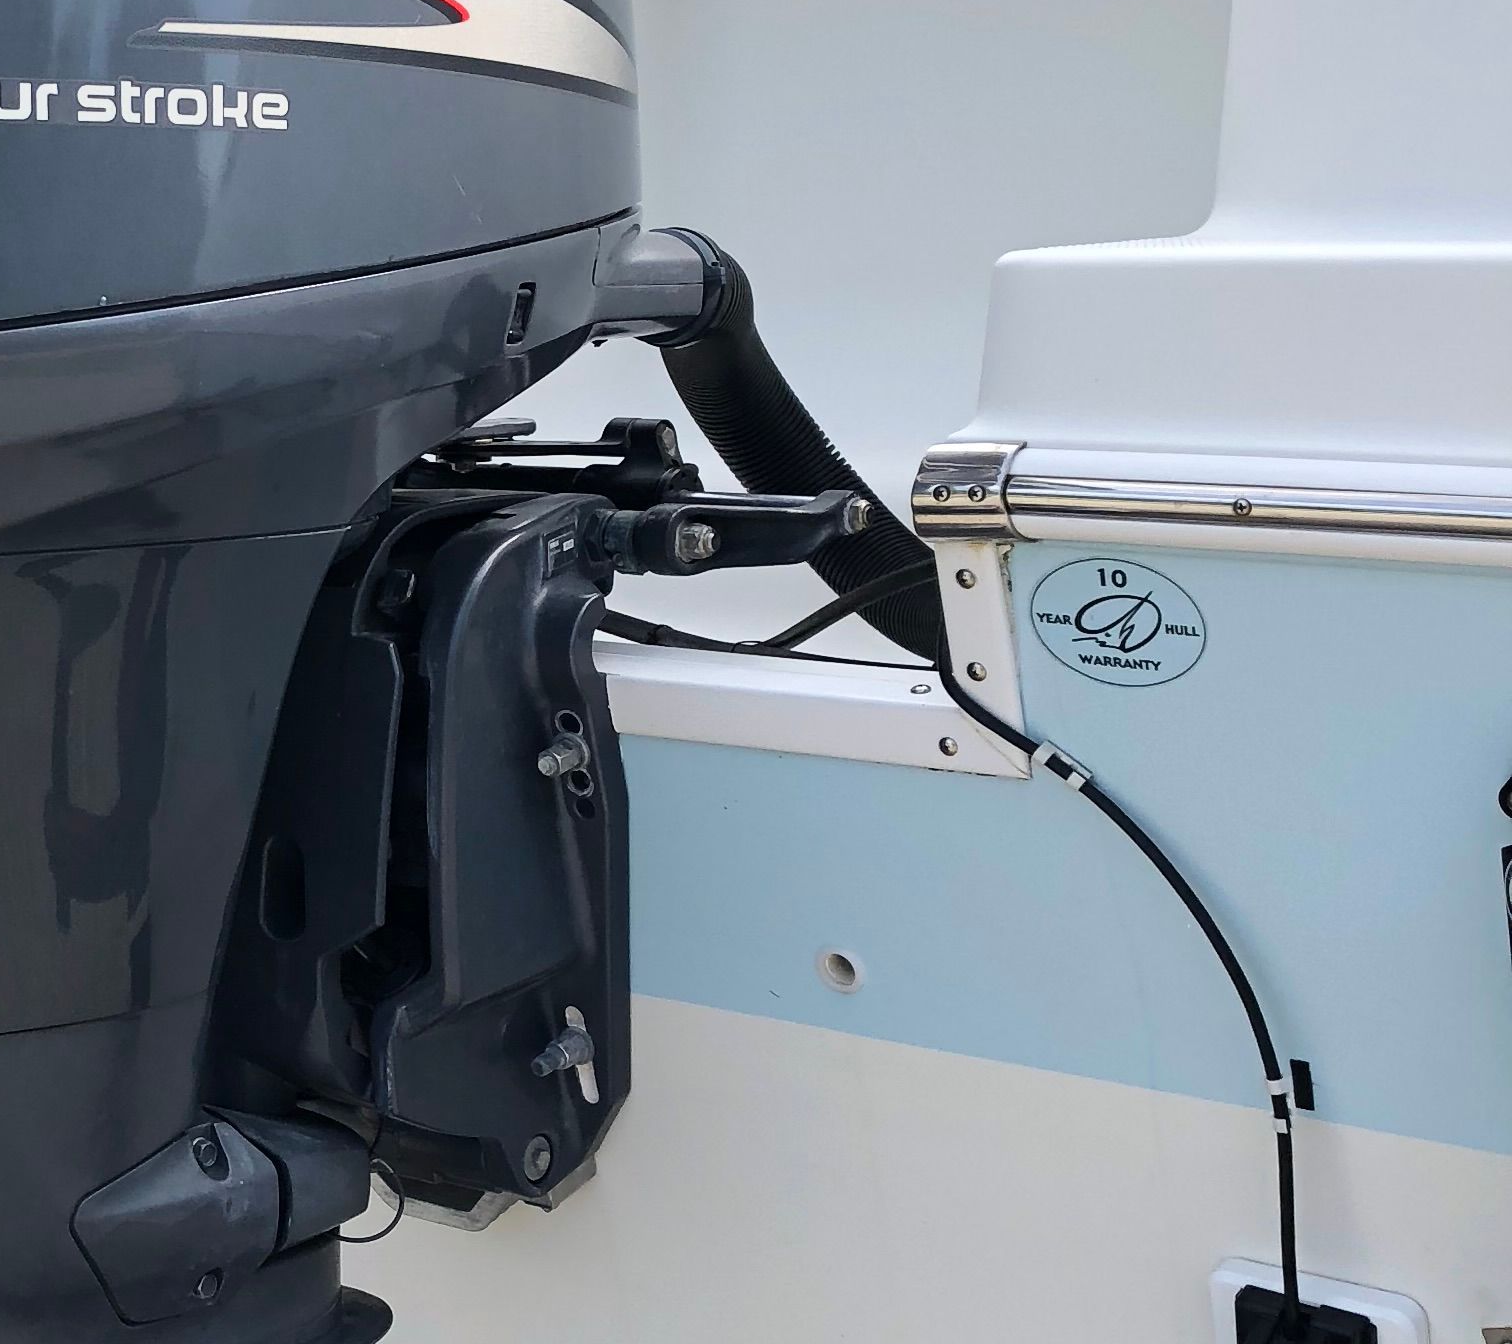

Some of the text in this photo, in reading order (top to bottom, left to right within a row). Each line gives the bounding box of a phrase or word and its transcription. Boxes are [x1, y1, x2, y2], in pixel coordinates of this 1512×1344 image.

[1096, 567, 1128, 588] 10
[1035, 612, 1201, 638] YEAR HULL
[1077, 653, 1162, 671] WARRANTY
